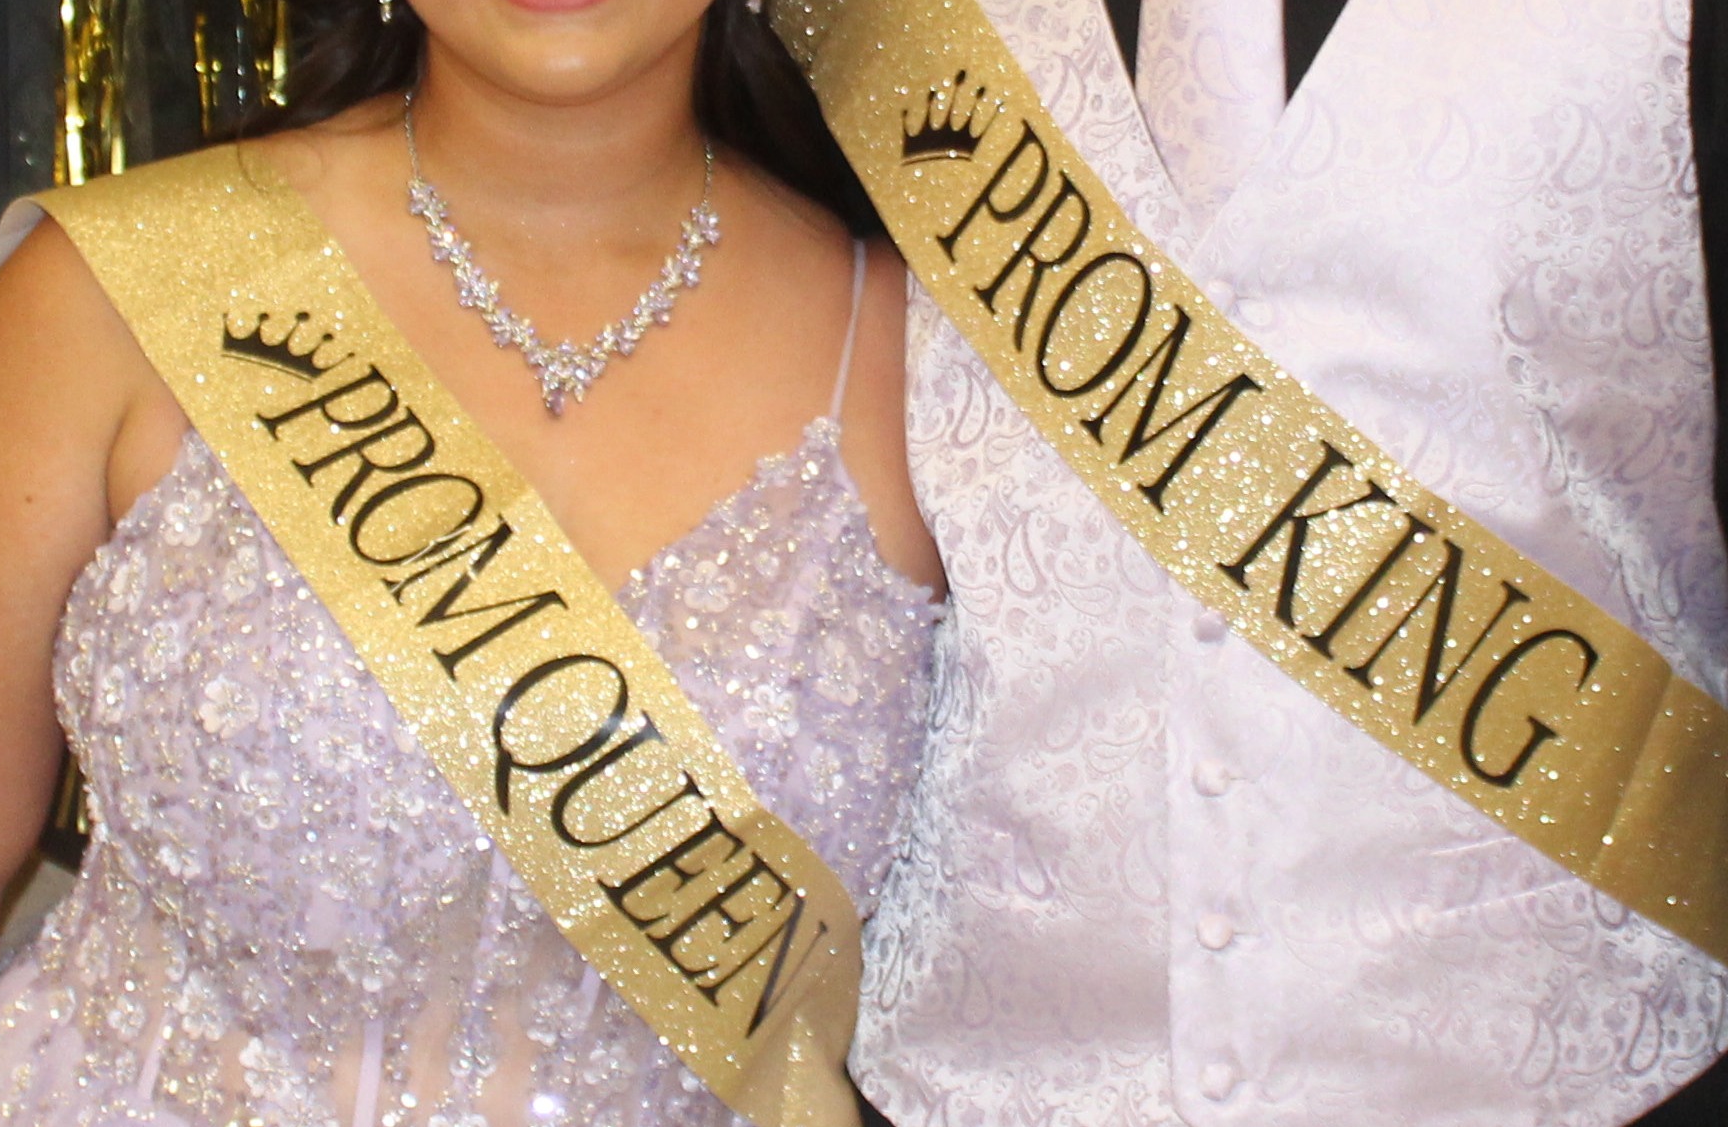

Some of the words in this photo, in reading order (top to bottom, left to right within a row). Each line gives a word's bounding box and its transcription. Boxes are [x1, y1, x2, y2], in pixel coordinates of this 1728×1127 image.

[255, 363, 569, 682] PROM
[492, 653, 828, 1040] QUEEN
[935, 118, 1264, 516] PROM
[1219, 438, 1599, 788] KING
